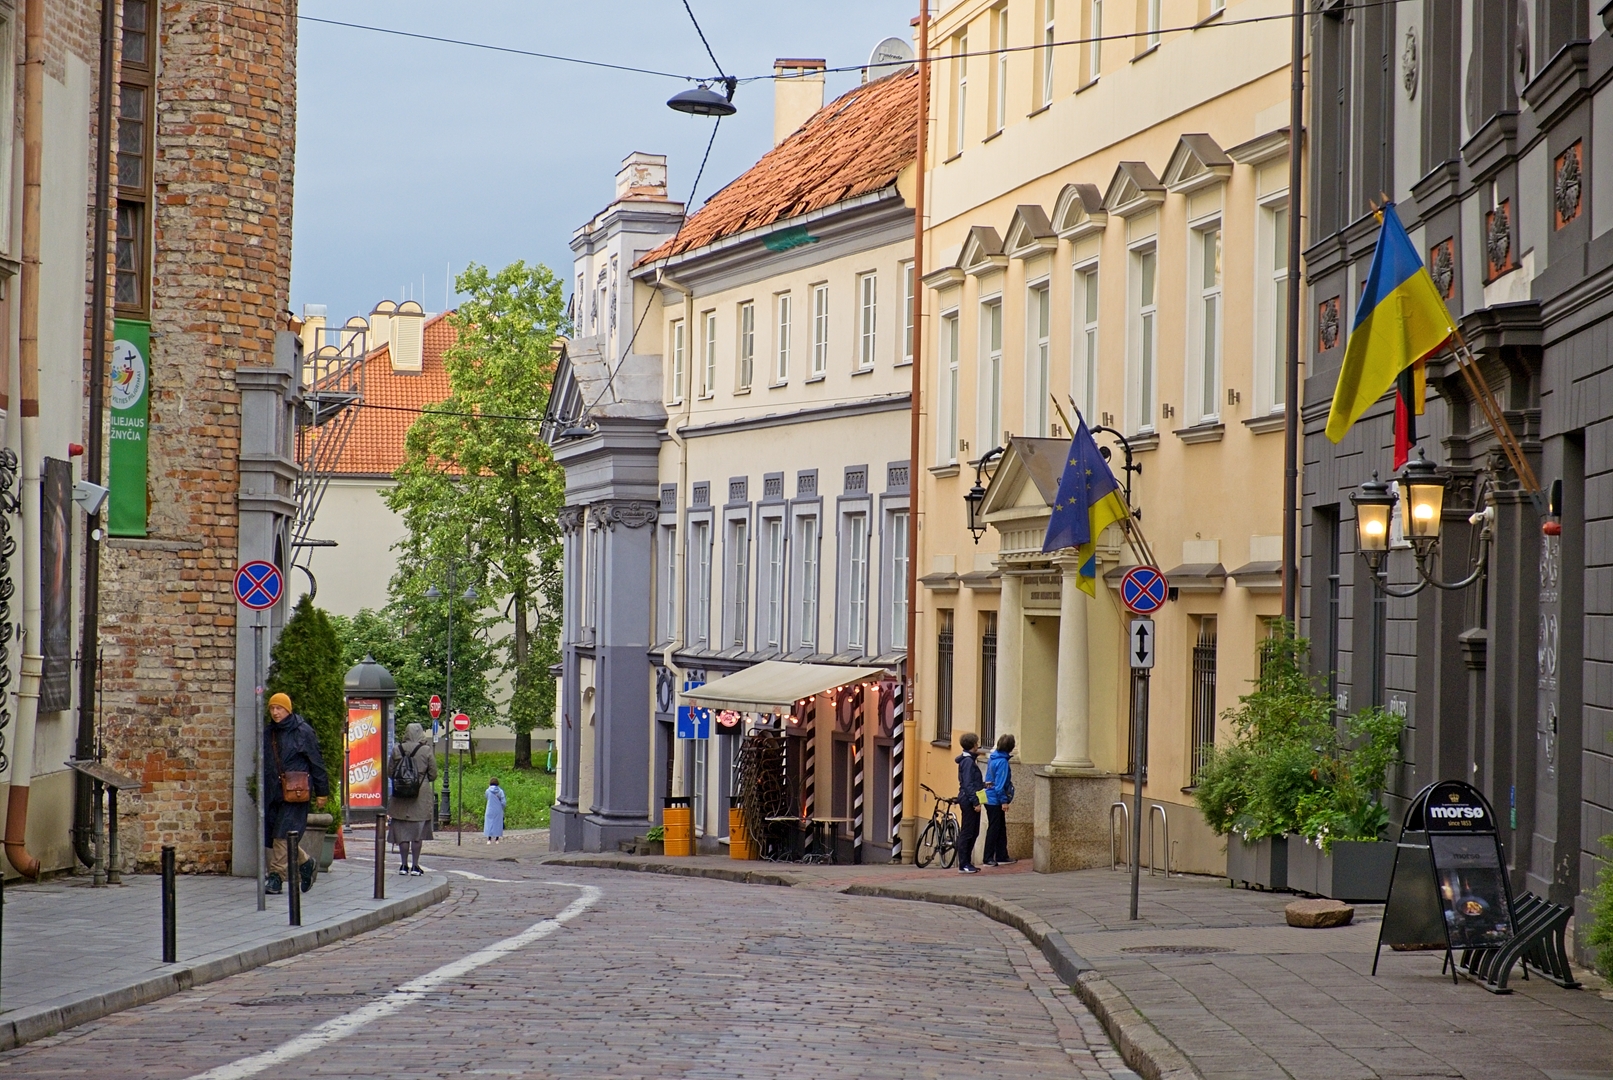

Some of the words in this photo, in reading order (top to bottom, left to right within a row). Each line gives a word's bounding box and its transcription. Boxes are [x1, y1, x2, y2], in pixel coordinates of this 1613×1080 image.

[112, 394, 128, 404] VILTIES
[128, 371, 141, 401] PILIGRIMAI
[430, 702, 441, 711] STOP
[348, 721, 376, 742] 60%
[349, 763, 377, 784] 60%
[1431, 807, 1484, 818] morsø
